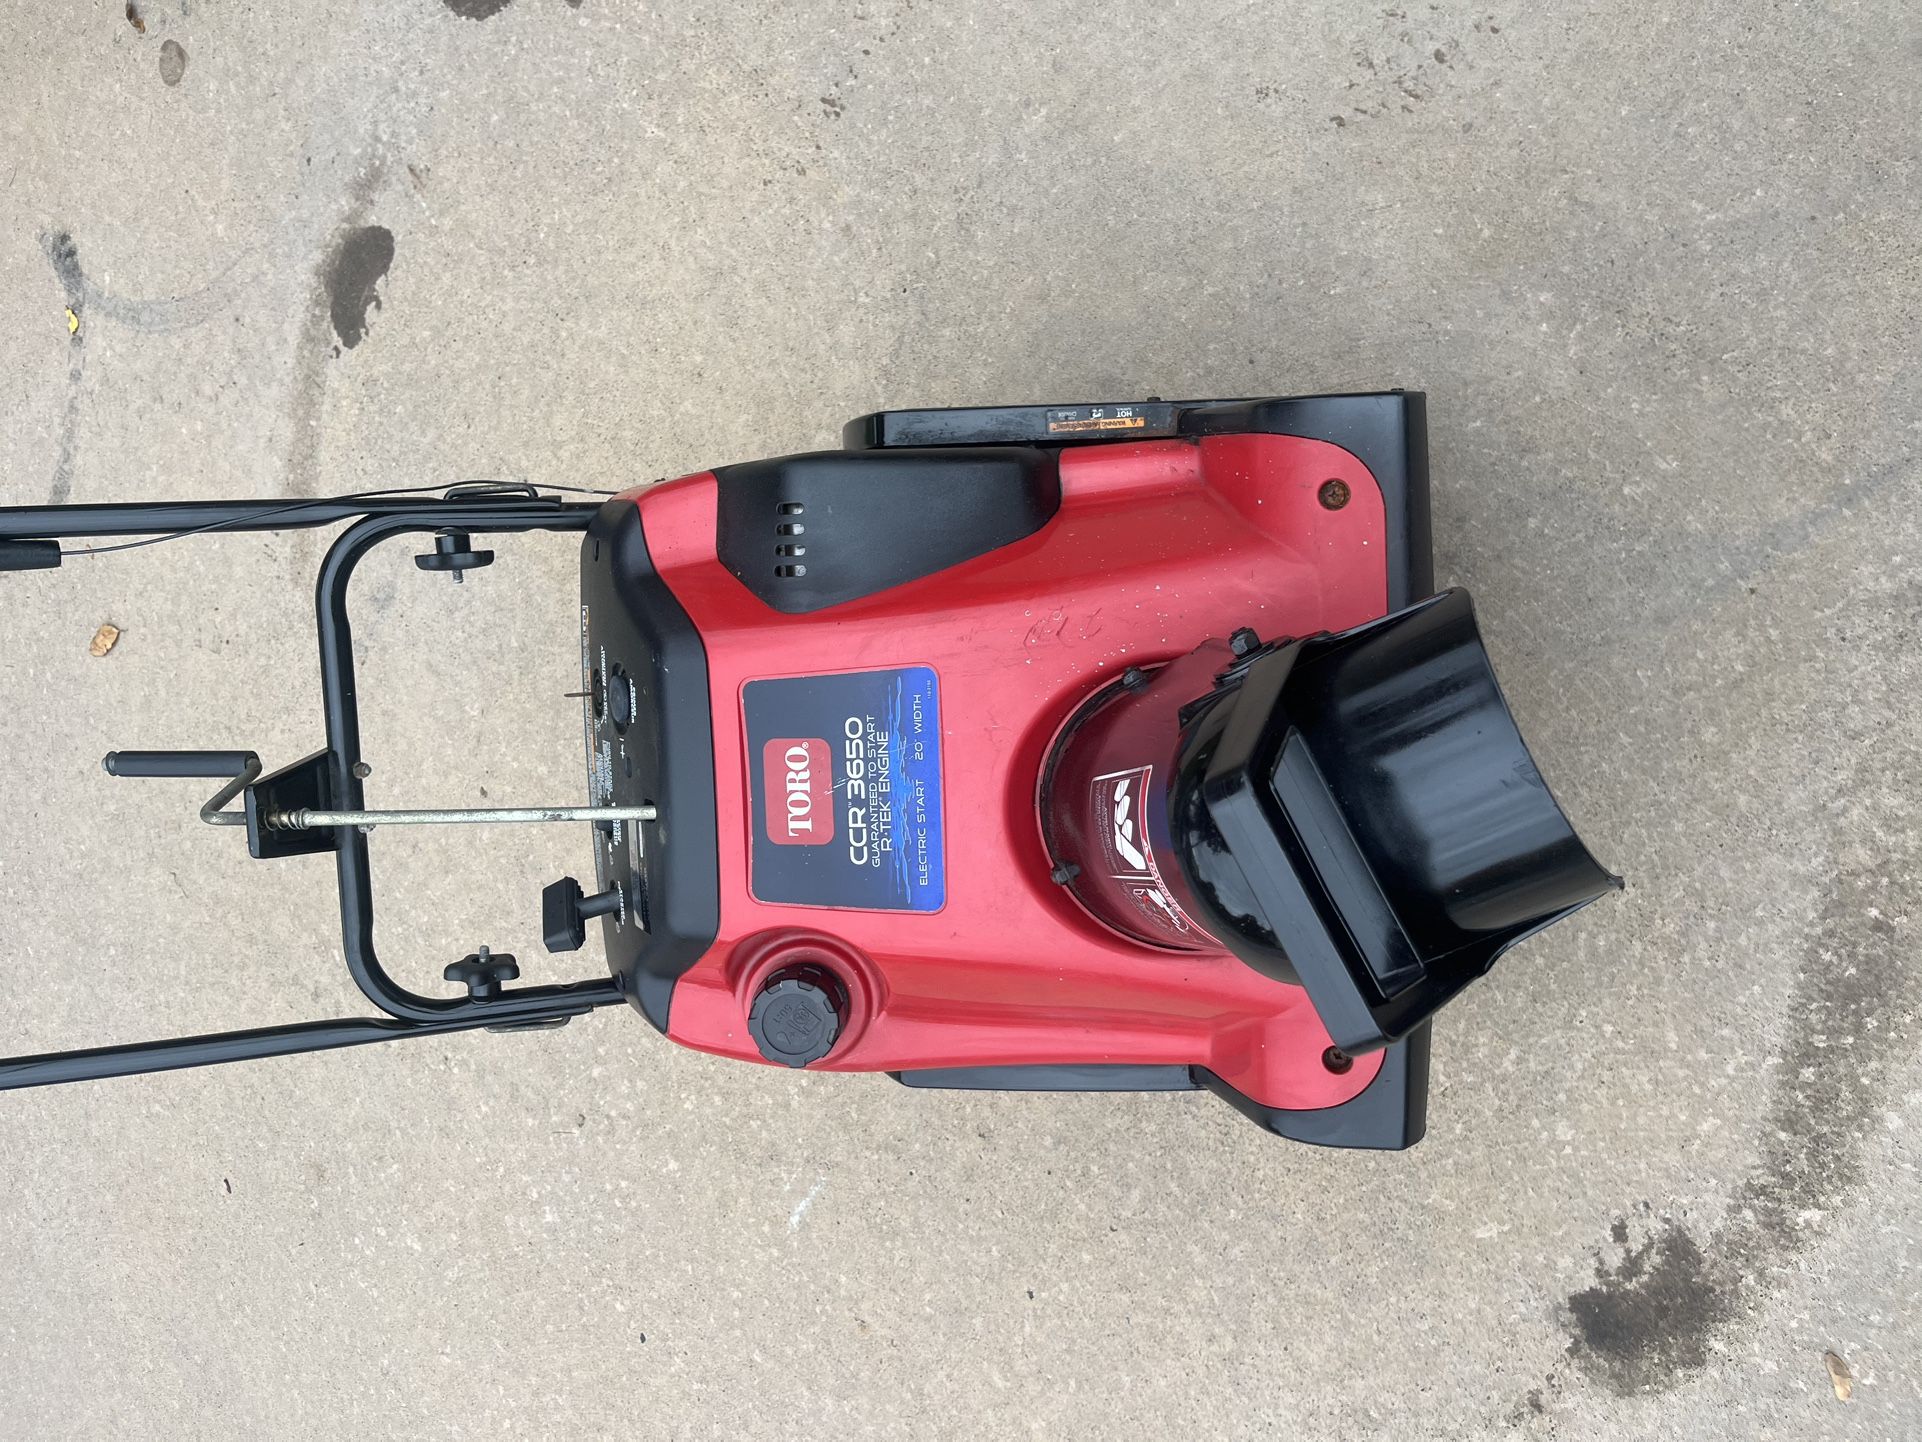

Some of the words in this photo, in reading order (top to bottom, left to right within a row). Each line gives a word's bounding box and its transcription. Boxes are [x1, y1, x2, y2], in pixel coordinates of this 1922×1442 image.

[866, 715, 876, 758] START
[913, 694, 923, 733] WIDTH
[845, 717, 866, 799] 3650
[868, 762, 877, 778] TO
[877, 731, 889, 792] ENGINE
[869, 783, 881, 867] GUARANTEED
[915, 779, 925, 823] START
[917, 828, 928, 886] ELECTRIC
[1149, 861, 1182, 912] DANGER
